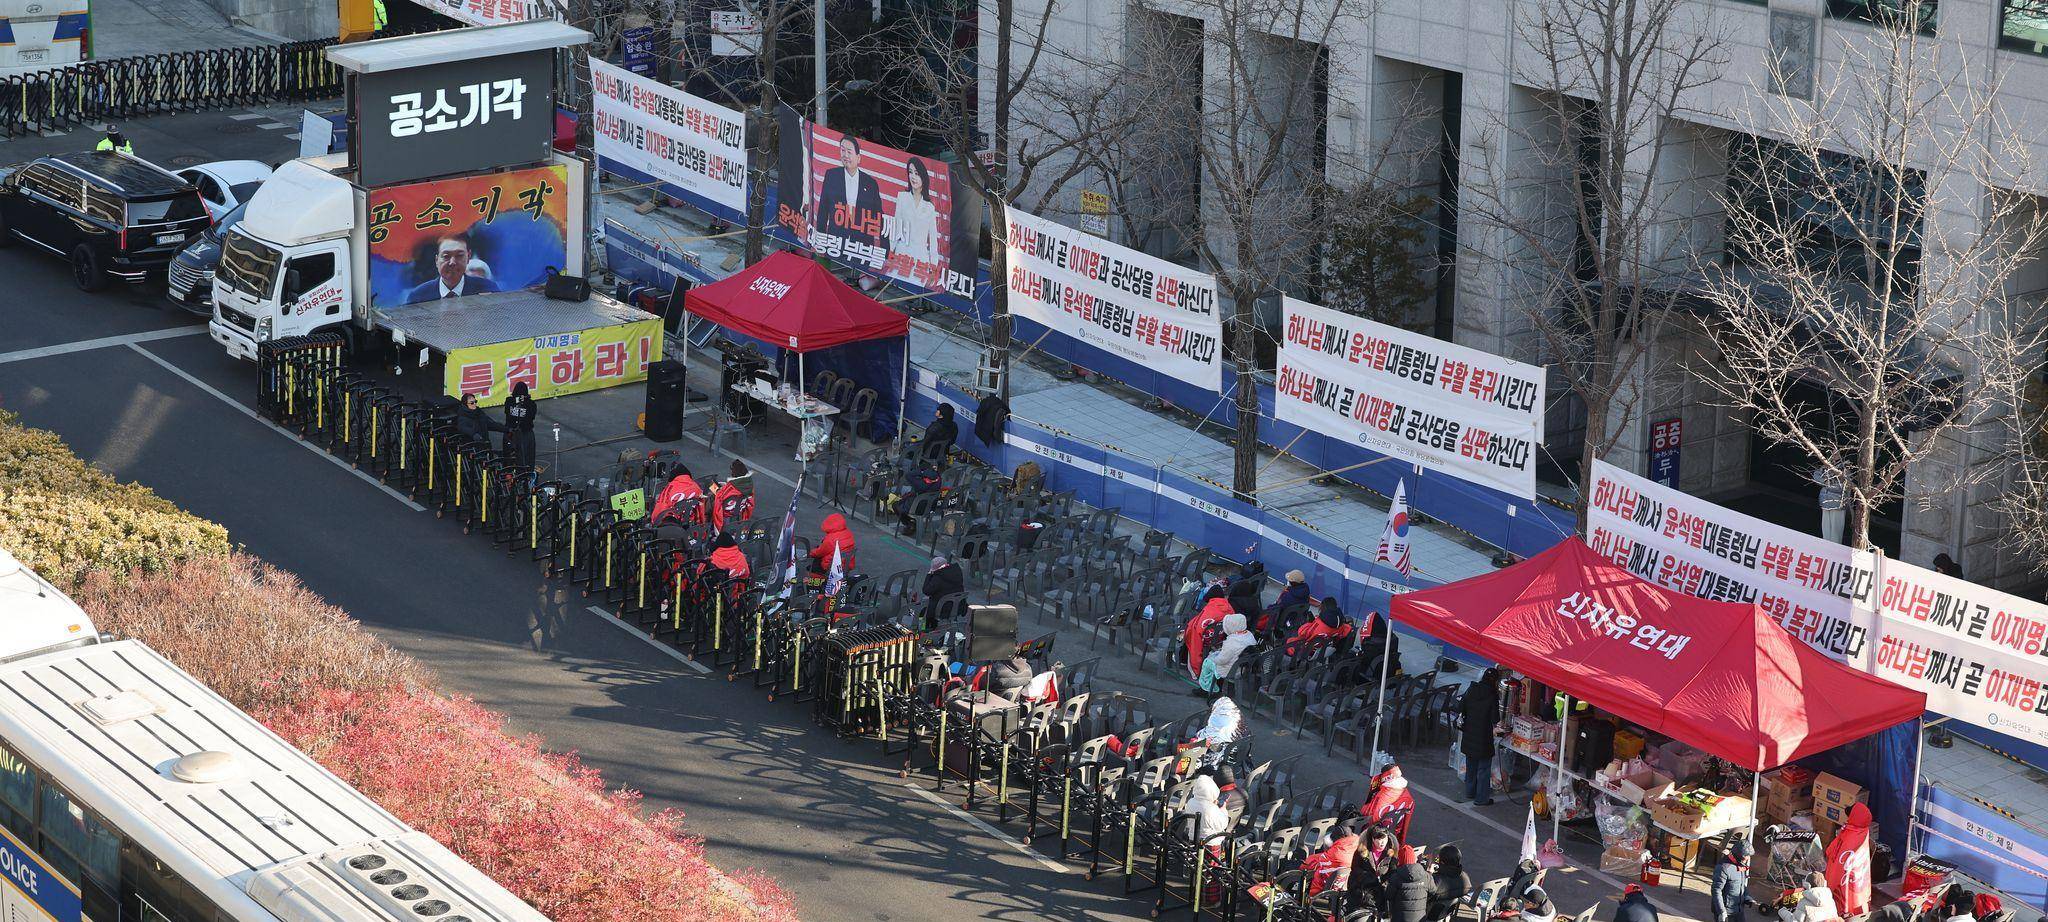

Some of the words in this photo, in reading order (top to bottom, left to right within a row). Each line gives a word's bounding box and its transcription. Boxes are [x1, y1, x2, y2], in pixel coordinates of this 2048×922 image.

[389, 77, 527, 138] 공소기각
[594, 70, 631, 106] 하나님께서
[632, 83, 684, 127] 윤석열대통령님
[686, 106, 701, 134] 부활
[703, 113, 742, 150] 복귀시킨다
[595, 108, 634, 146] 하나님께서
[636, 126, 643, 150] 곧
[645, 129, 676, 162] 이재명과
[677, 141, 706, 175] 공산당을
[709, 153, 745, 190] 심판하신다
[370, 180, 554, 244] 공소기각
[843, 238, 887, 270] 부부를
[1009, 220, 1056, 264] 하나님께서
[1057, 240, 1068, 268] 곧
[1070, 244, 1110, 284] 이재명과
[1111, 259, 1154, 300] 공산당을
[1156, 274, 1213, 316] 심판하신다
[296, 287, 336, 316] 신자유연대
[749, 275, 792, 300] 신자유연대
[1011, 266, 1062, 309] 하나님께서
[1063, 285, 1135, 338] 윤석열대통령님
[1136, 313, 1159, 347] 부활
[1160, 320, 1216, 365] 복귀시킨다
[459, 335, 651, 398] 특검하라!
[534, 333, 580, 350] 이재명을
[1288, 313, 1349, 358] 하나님께서
[1349, 332, 1440, 387] 윤석열대통령님
[1440, 358, 1469, 395] 부활
[1469, 366, 1538, 414] 복귀시킨다
[1278, 364, 1340, 412] 하나님께서
[1339, 387, 1355, 418] 곧
[1353, 393, 1406, 435] 이재명과
[1405, 408, 1461, 453] 공산당을
[1461, 426, 1529, 472] 심판하신다
[1654, 421, 1681, 449] 공증
[1034, 444, 1050, 456] 안전
[1058, 451, 1073, 464] 제일
[1109, 469, 1125, 480] 제일
[619, 492, 639, 507] 부산
[1190, 496, 1206, 509] 안전
[1214, 506, 1230, 519] 제일
[1286, 537, 1300, 551] 안전
[1306, 547, 1320, 560] 제일
[1593, 477, 1662, 532] 하나님께서
[1664, 506, 1762, 570] 윤석열대통령님
[1761, 541, 1794, 581] 부활
[1794, 551, 1873, 604] 복귀시킨다
[1380, 579, 1398, 592] 안전
[1591, 526, 1660, 581] 하나님께서
[1787, 604, 1867, 660] 복귀시킨다
[1556, 591, 1692, 660] 신자유연대
[1881, 576, 1968, 632] 하나님께서
[1967, 604, 1990, 639] 곧
[1991, 610, 2048, 657] 이재명
[1877, 634, 1964, 690] 하나님께서
[1961, 661, 1985, 696] 곧
[1966, 821, 1985, 837] 안전
[1995, 837, 2014, 851] 제일
[0, 846, 38, 896] OLICE
